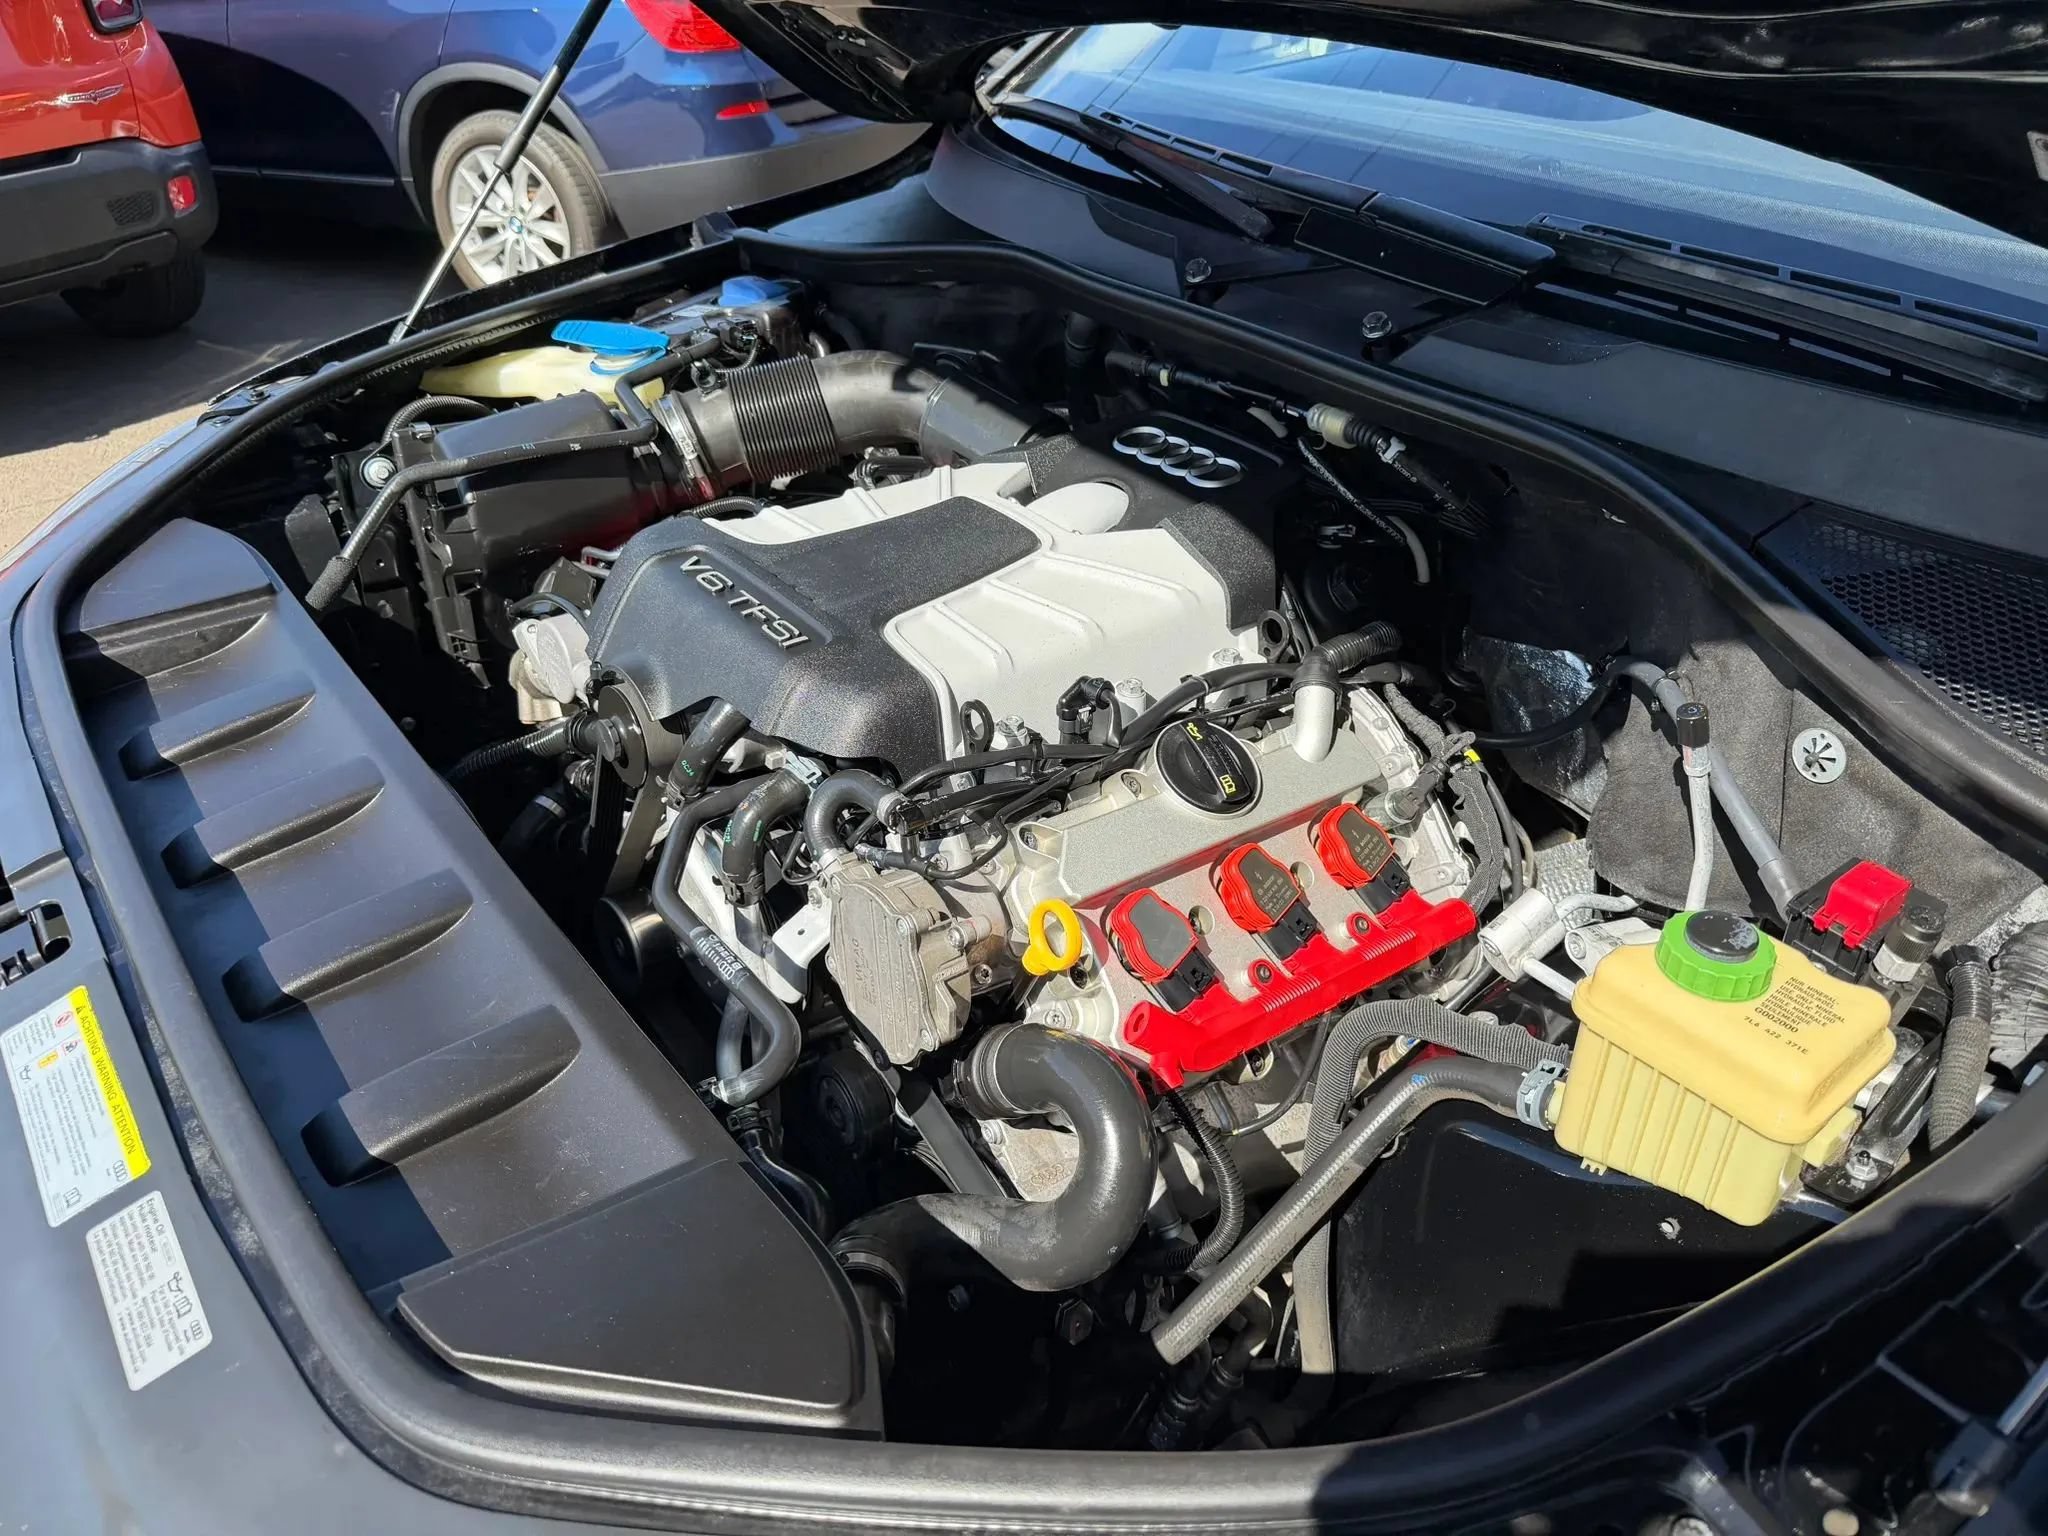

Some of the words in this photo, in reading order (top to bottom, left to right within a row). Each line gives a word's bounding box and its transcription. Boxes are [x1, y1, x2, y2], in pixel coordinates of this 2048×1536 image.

[679, 555, 735, 596] V6
[728, 589, 811, 651] TFSI
[1779, 984, 1794, 994] USE
[1795, 993, 1813, 1004] ONLY
[1814, 1003, 1846, 1023] MINERAL
[1788, 976, 1805, 986] NUR
[1806, 985, 1840, 1005] MINERAL-
[1753, 1006, 1799, 1033] G002000
[1759, 1001, 1800, 1026] SEULEMENT
[1764, 997, 1811, 1025] HYDRAULIQUE
[1768, 993, 1790, 1006] HUILE
[1791, 1005, 1827, 1027] MINERALE
[1774, 988, 1813, 1011] HYDRAULIC
[1813, 1010, 1836, 1024] FLUID
[1786, 1040, 1808, 1054] 371E
[78, 1013, 100, 1057] ACHTUNG
[94, 1055, 117, 1102] WARNING
[110, 1101, 137, 1157] ATTENTION
[146, 1197, 160, 1225] Engine
[144, 1223, 157, 1253] moteur
